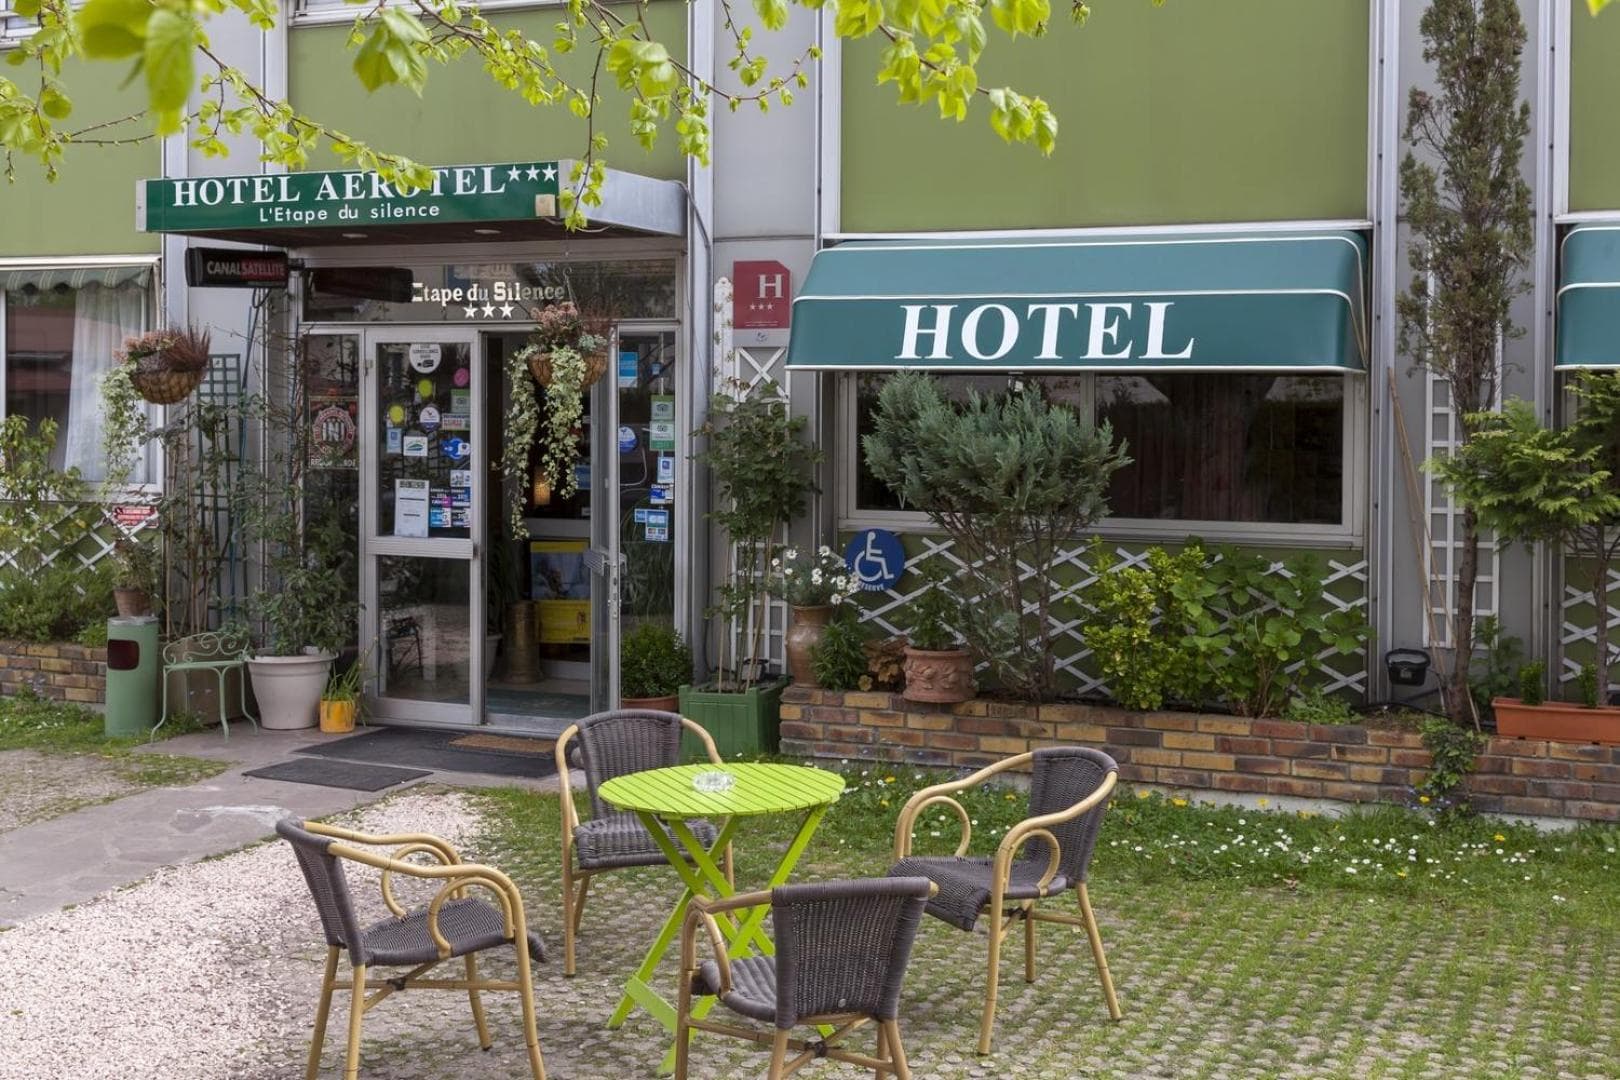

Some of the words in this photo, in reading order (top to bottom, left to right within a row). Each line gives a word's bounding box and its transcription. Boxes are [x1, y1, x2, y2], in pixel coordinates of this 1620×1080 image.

[172, 176, 300, 207] HOTEL
[260, 206, 328, 224] L'Etape
[338, 204, 359, 219] du
[371, 202, 440, 218] silence
[467, 282, 489, 302] du
[493, 281, 566, 302] Silence
[756, 273, 784, 299] H
[894, 302, 1195, 360] HOTEL
